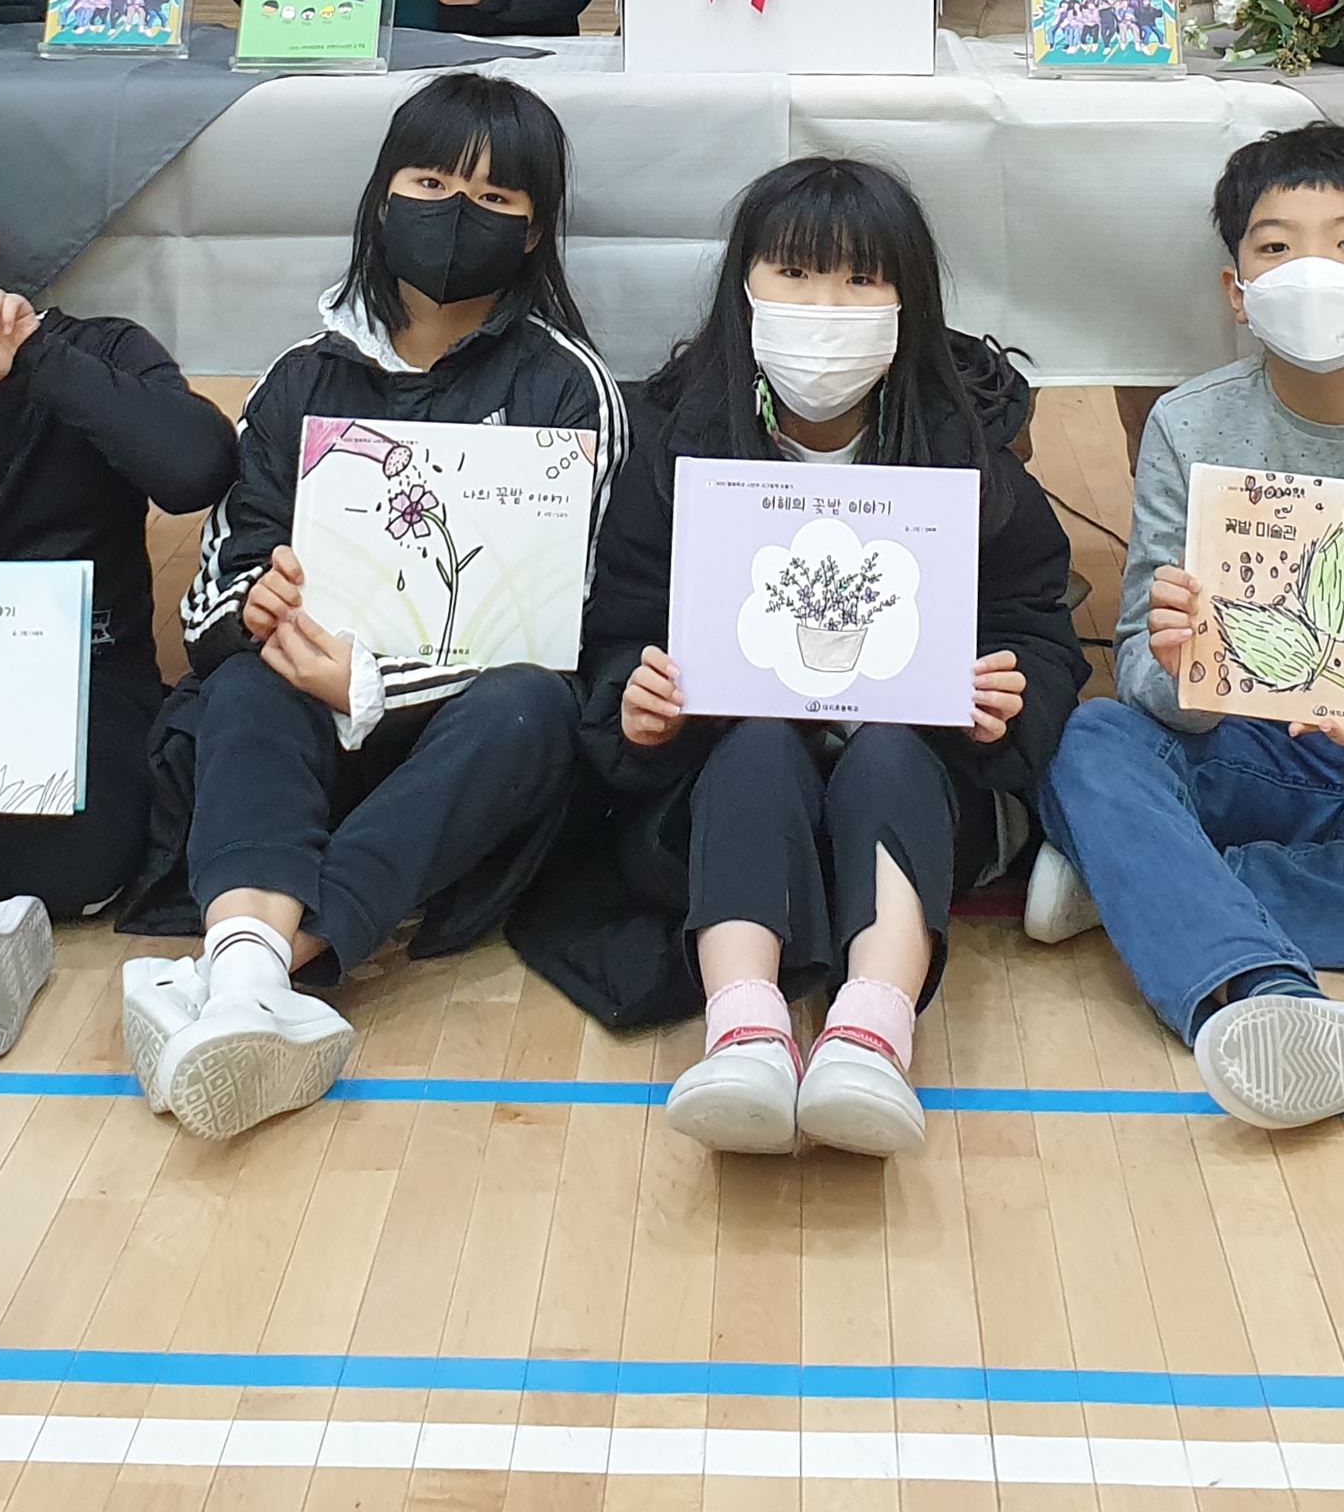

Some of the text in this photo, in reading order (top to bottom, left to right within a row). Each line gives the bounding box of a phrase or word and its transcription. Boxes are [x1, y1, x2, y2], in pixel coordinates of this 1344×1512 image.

[463, 489, 490, 501] 나의
[528, 490, 570, 504] 이야기
[848, 500, 892, 516] 이야기
[1225, 517, 1297, 541] 꽃밭 미술관
